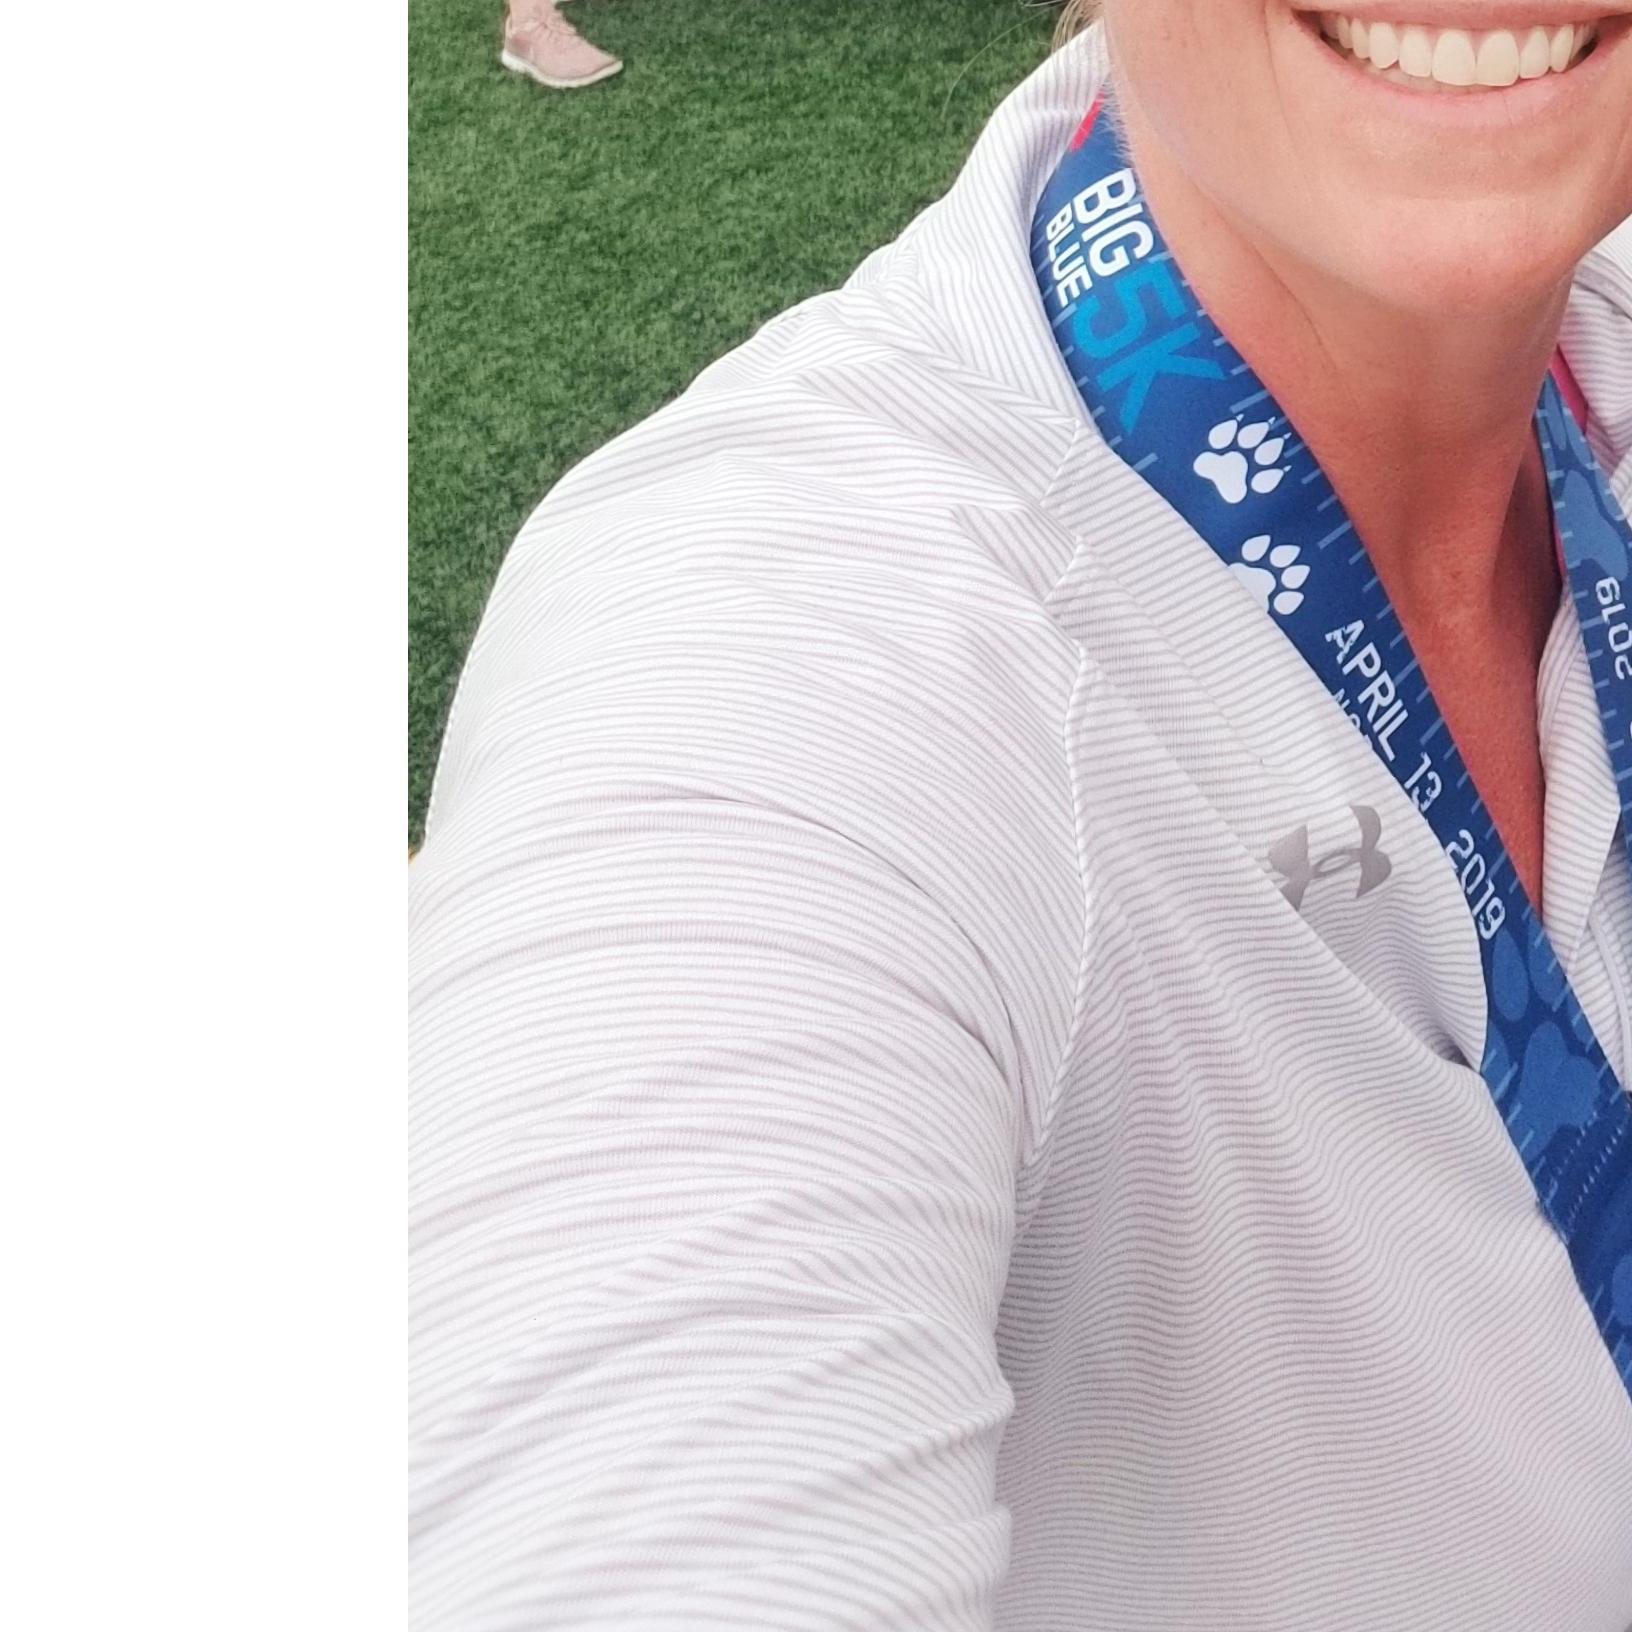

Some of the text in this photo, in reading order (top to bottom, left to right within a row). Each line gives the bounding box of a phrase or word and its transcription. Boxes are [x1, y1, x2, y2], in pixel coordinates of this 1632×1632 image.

[1046, 203, 1093, 307] BLUE
[1072, 167, 1154, 277] BIG
[1072, 259, 1228, 435] 5K
[1325, 619, 1408, 761] APRIL
[1404, 751, 1442, 812] 13
[1445, 829, 1506, 941] 2019
